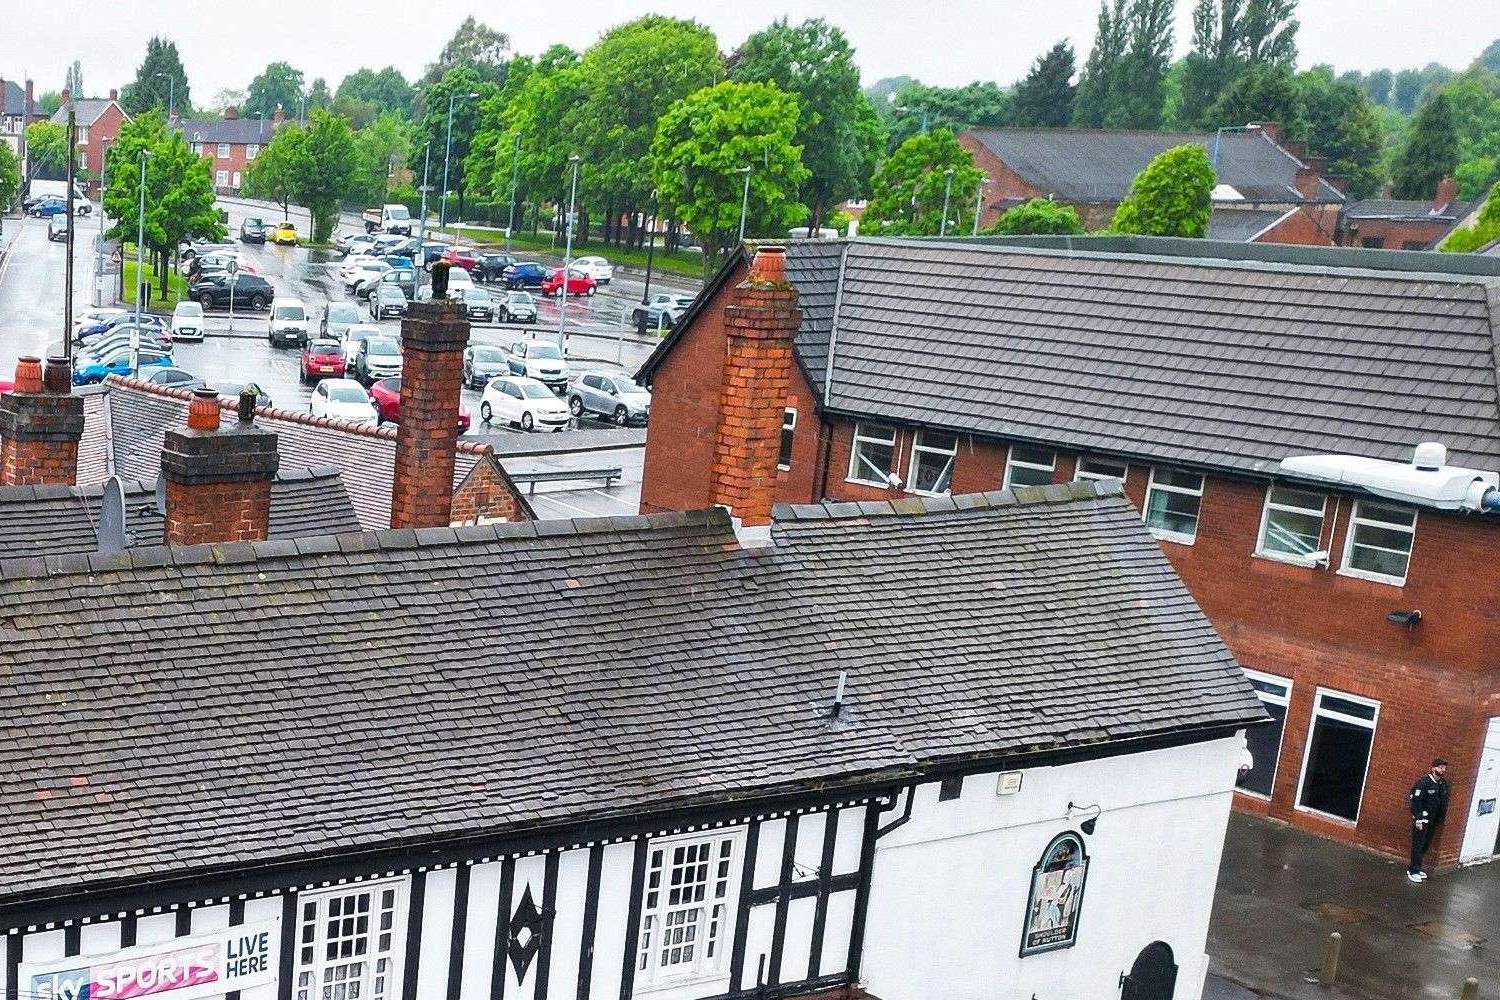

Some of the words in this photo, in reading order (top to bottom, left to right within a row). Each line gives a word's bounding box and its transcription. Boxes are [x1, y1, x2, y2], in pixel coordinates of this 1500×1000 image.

[227, 931, 269, 959] LIVE
[91, 952, 219, 997] SPORTS
[226, 954, 269, 979] HERE
